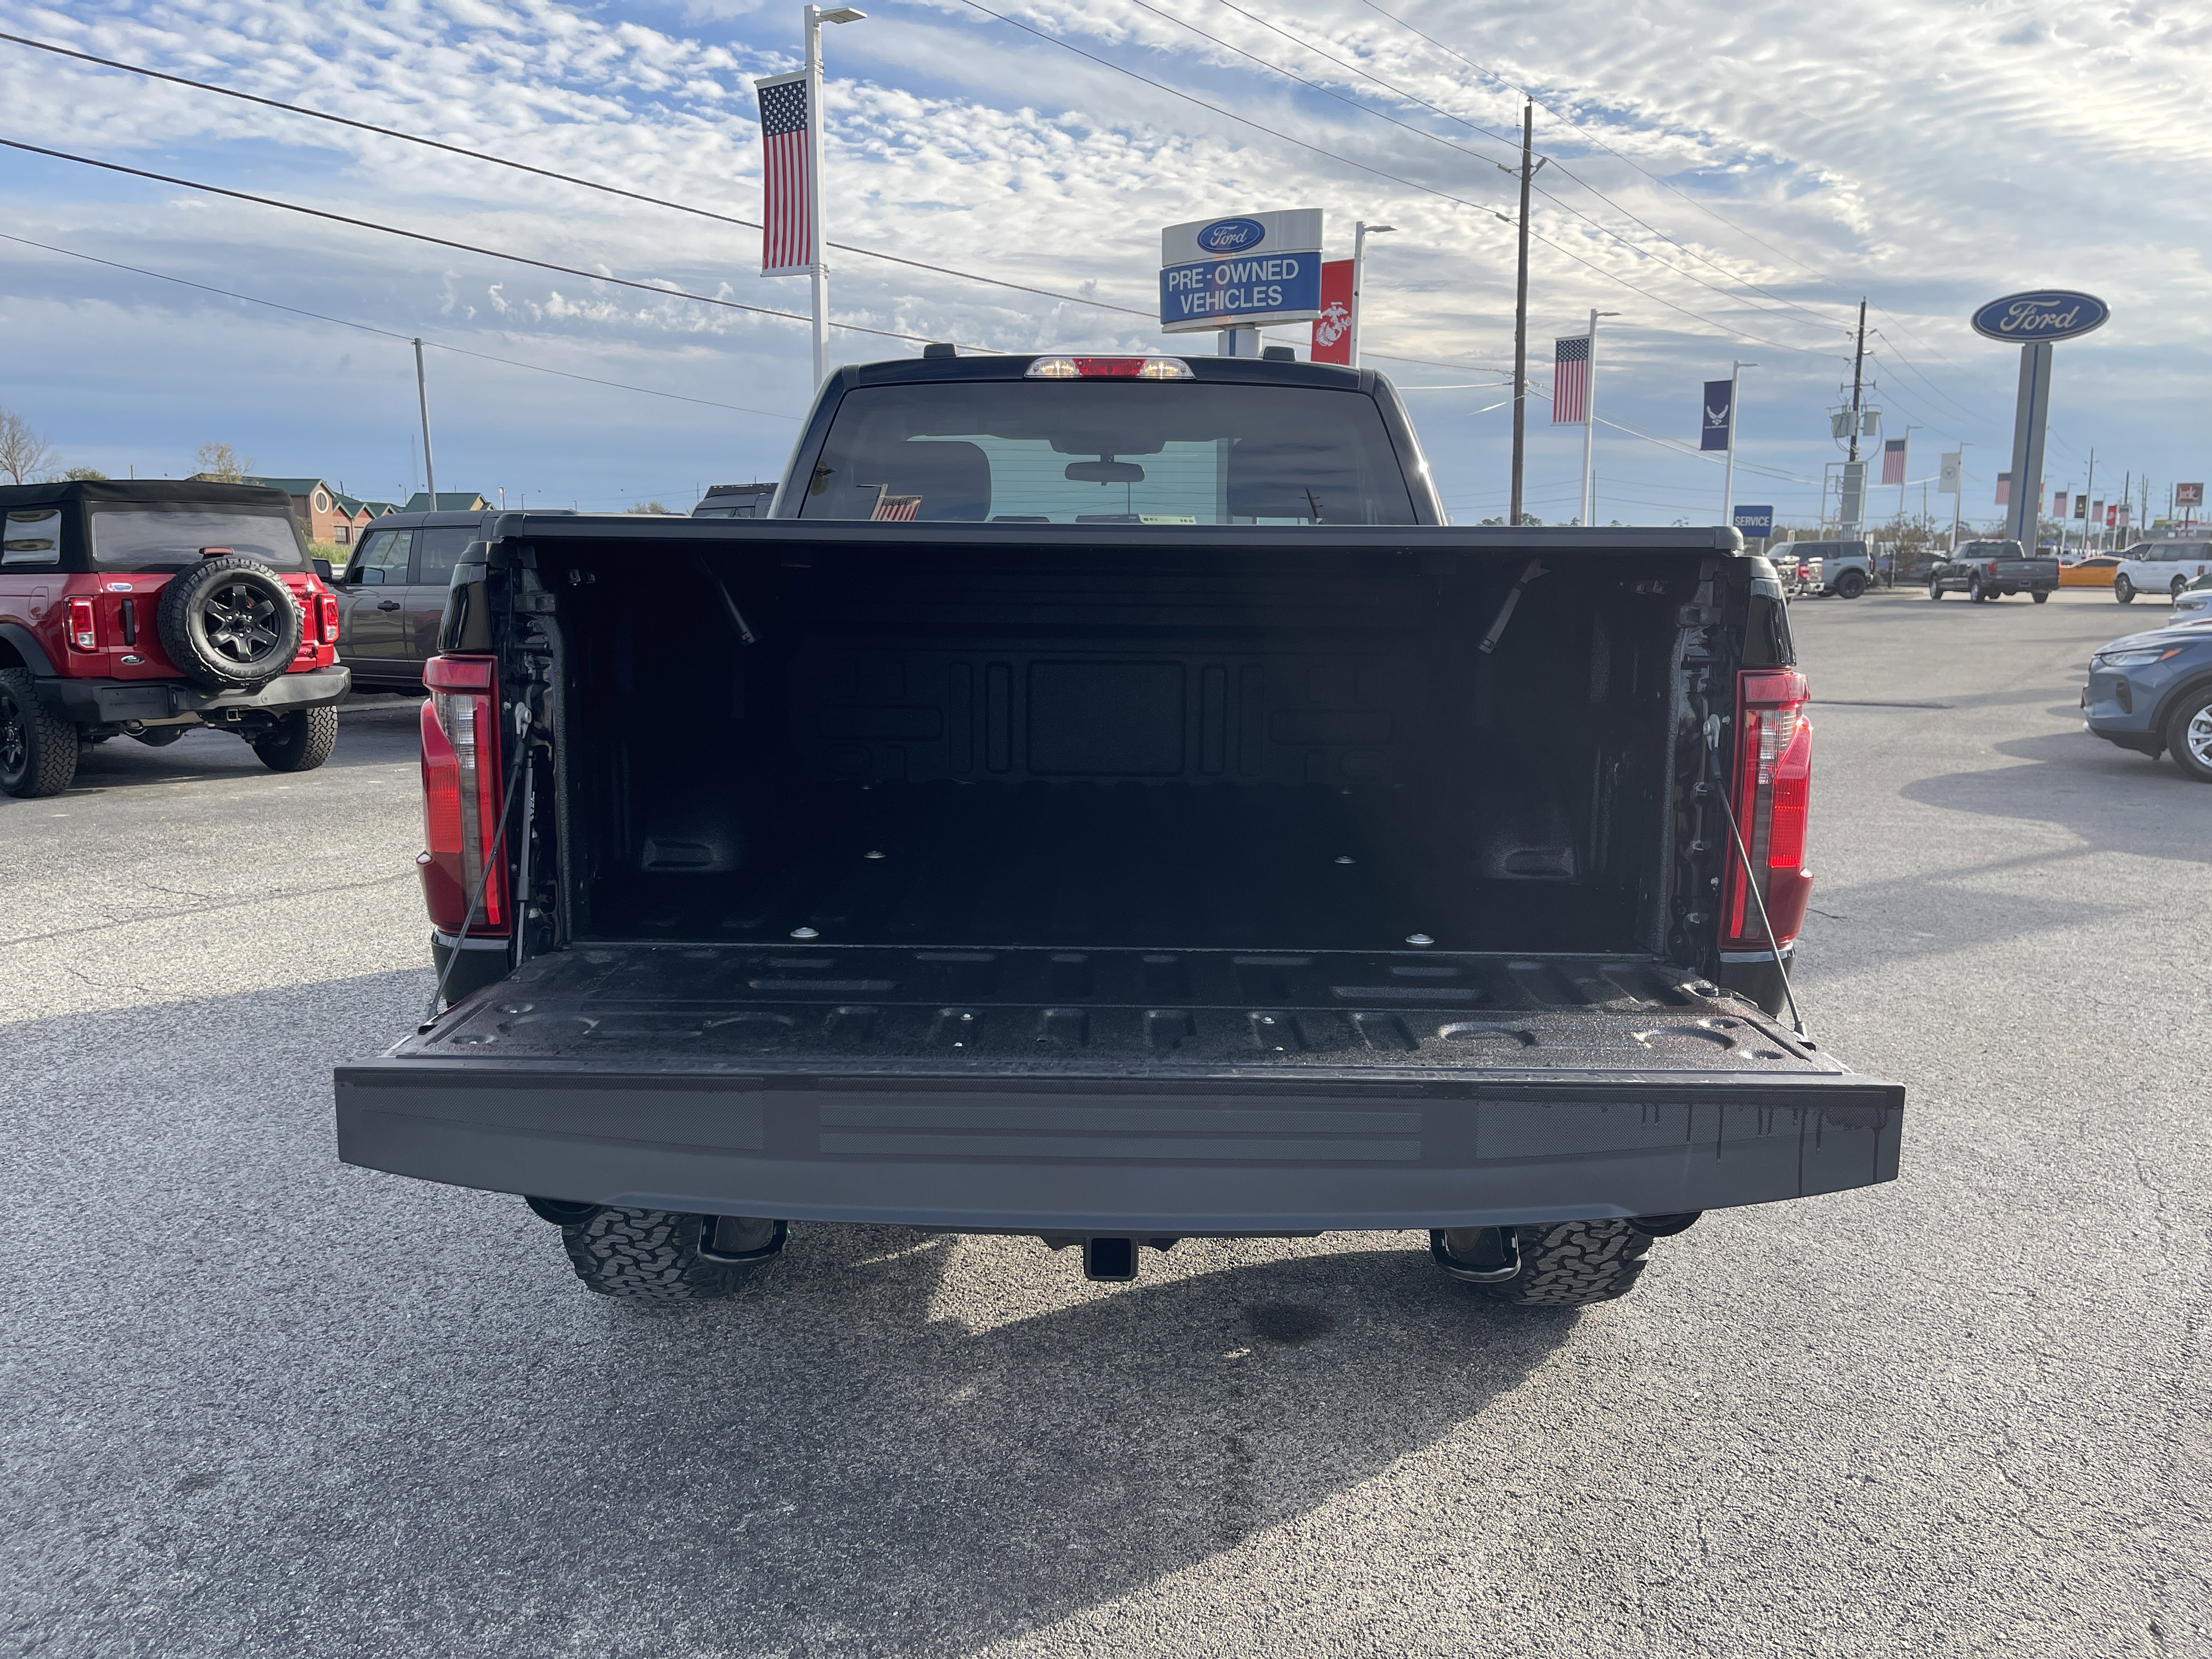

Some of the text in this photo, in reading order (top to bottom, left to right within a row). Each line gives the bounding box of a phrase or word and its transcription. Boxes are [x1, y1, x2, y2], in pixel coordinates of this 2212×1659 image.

[1210, 225, 1249, 247] Ford
[1169, 259, 1300, 292] PRE-OWNED
[1180, 285, 1283, 314] VEHICLES
[2000, 300, 2081, 331] Ford
[1735, 516, 1770, 527] SERVICE
